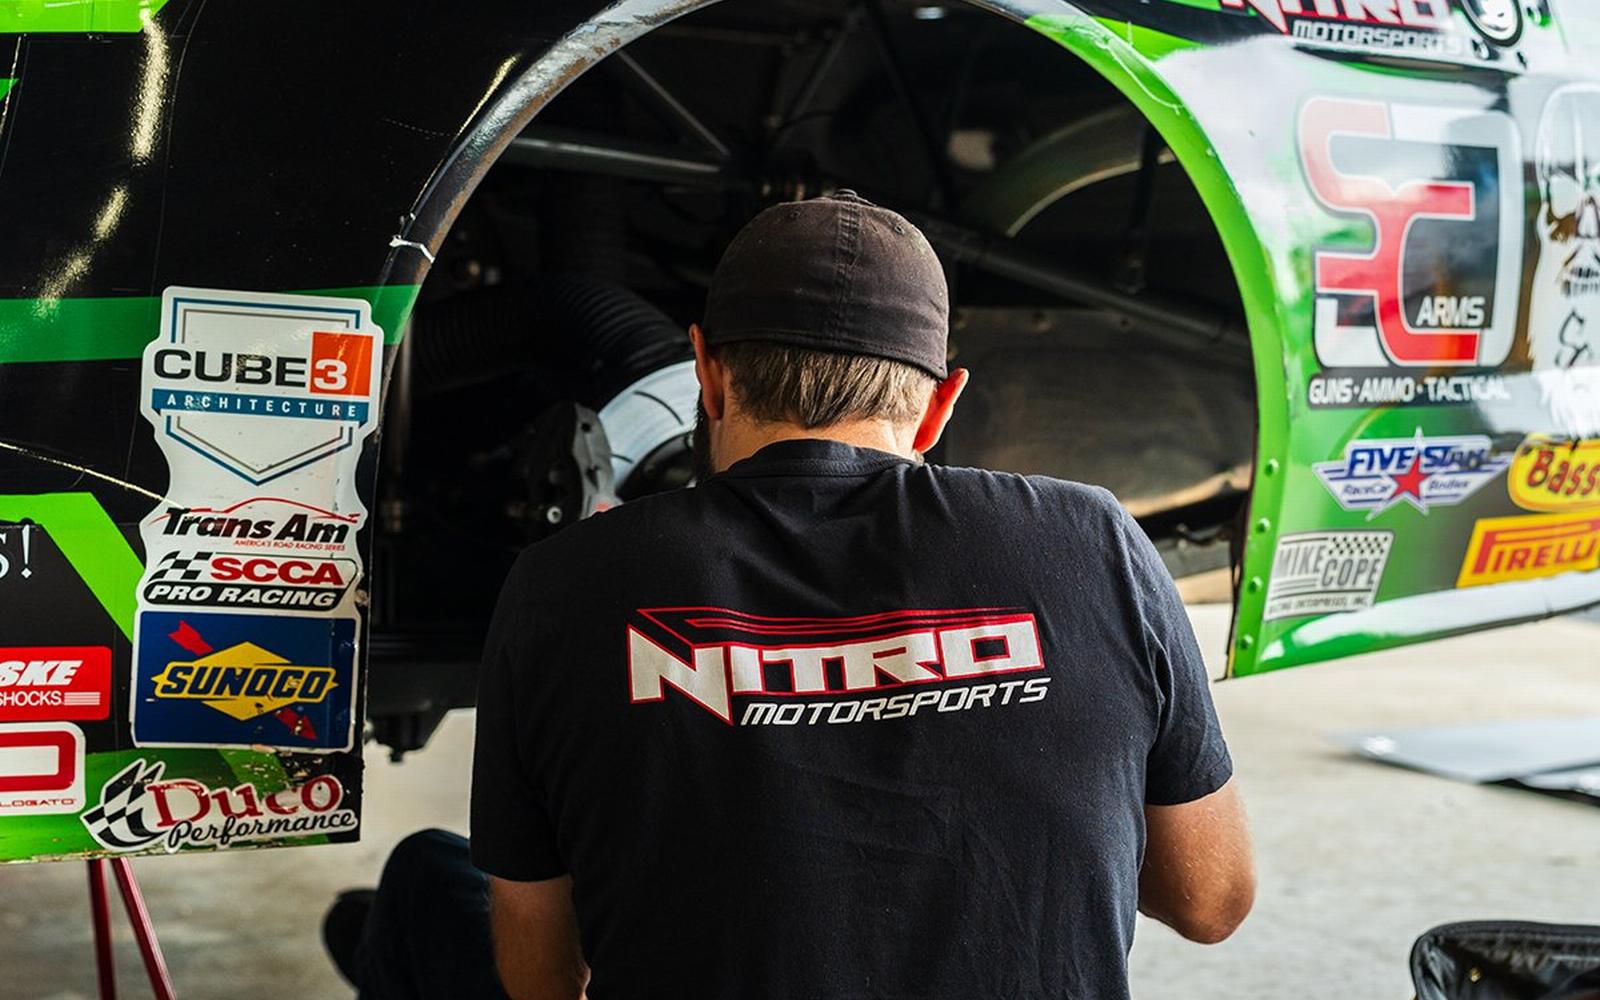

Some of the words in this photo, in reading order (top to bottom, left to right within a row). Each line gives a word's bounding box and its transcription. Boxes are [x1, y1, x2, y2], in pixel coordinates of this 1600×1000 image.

[1416, 296, 1486, 327] ARMS
[167, 393, 357, 417] ARCHITECTURE
[1309, 377, 1353, 404] GUNS
[1357, 376, 1415, 403] AMMO
[1348, 446, 1413, 477] FIVE
[163, 507, 274, 539] Trans
[274, 514, 350, 543] Am
[210, 557, 344, 586] SCCA
[1276, 545, 1326, 577] MIKE
[1321, 558, 1381, 588] COPE
[148, 584, 212, 602] PRO
[218, 587, 337, 607] RACING
[160, 665, 333, 699] SUNOCO
[628, 612, 1045, 726] NITRO
[739, 677, 1051, 727] MOTORSPORTS
[146, 775, 341, 828] Duco
[168, 812, 355, 848] Performance
